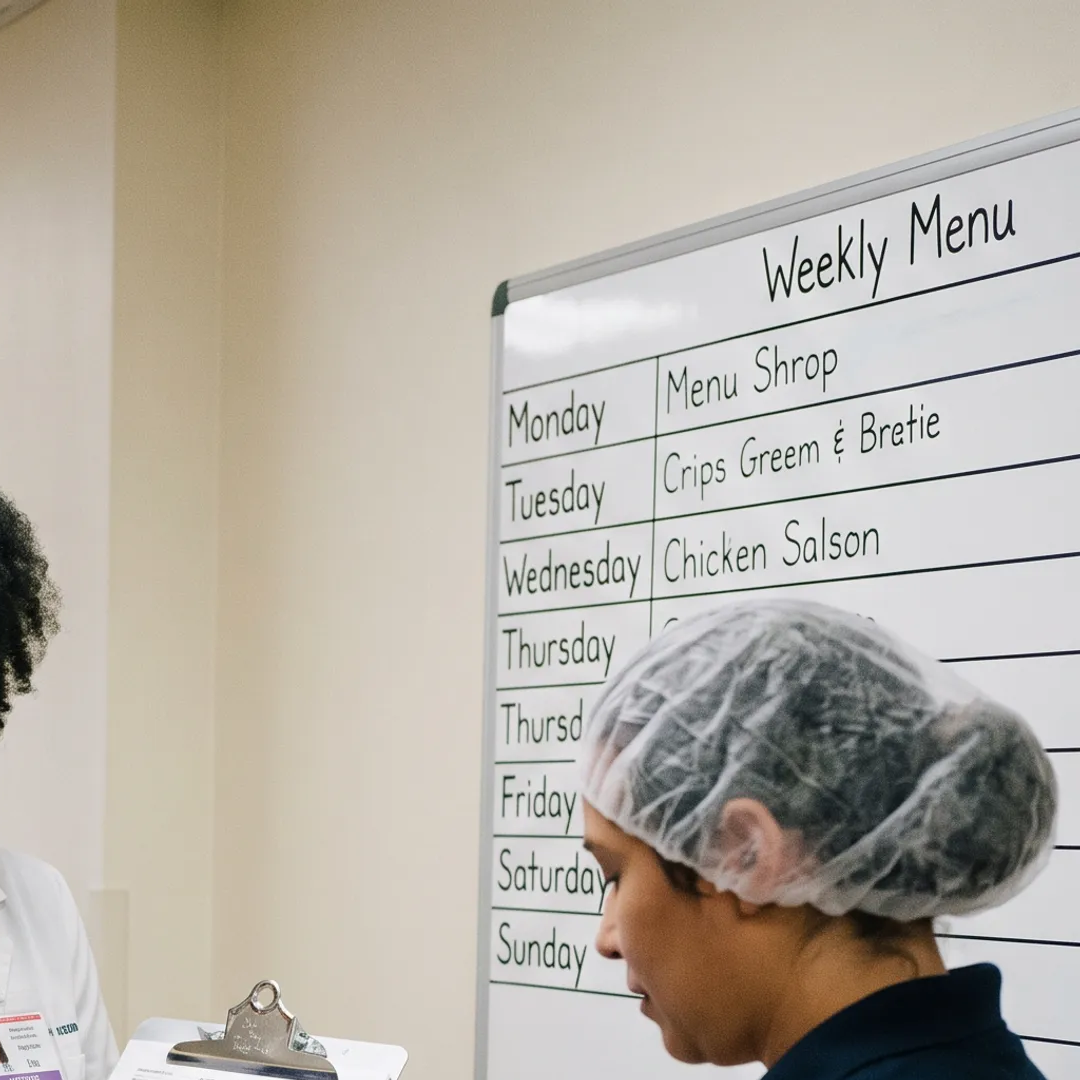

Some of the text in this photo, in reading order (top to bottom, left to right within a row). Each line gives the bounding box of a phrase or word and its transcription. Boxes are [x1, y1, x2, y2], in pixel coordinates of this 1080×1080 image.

[762, 193, 1016, 300] Weekly Menu
[667, 345, 838, 414] Menu Shrop
[508, 390, 606, 447] Monday
[663, 403, 941, 501] Crips Greem & Bretie
[505, 469, 606, 524] Tuesday
[503, 540, 641, 598] Wednesday
[664, 516, 880, 583] Chicken Salson
[501, 620, 616, 677] Thursday
[502, 774, 577, 834] Friday
[498, 848, 608, 913] Saturday
[497, 922, 587, 988] Sunday
